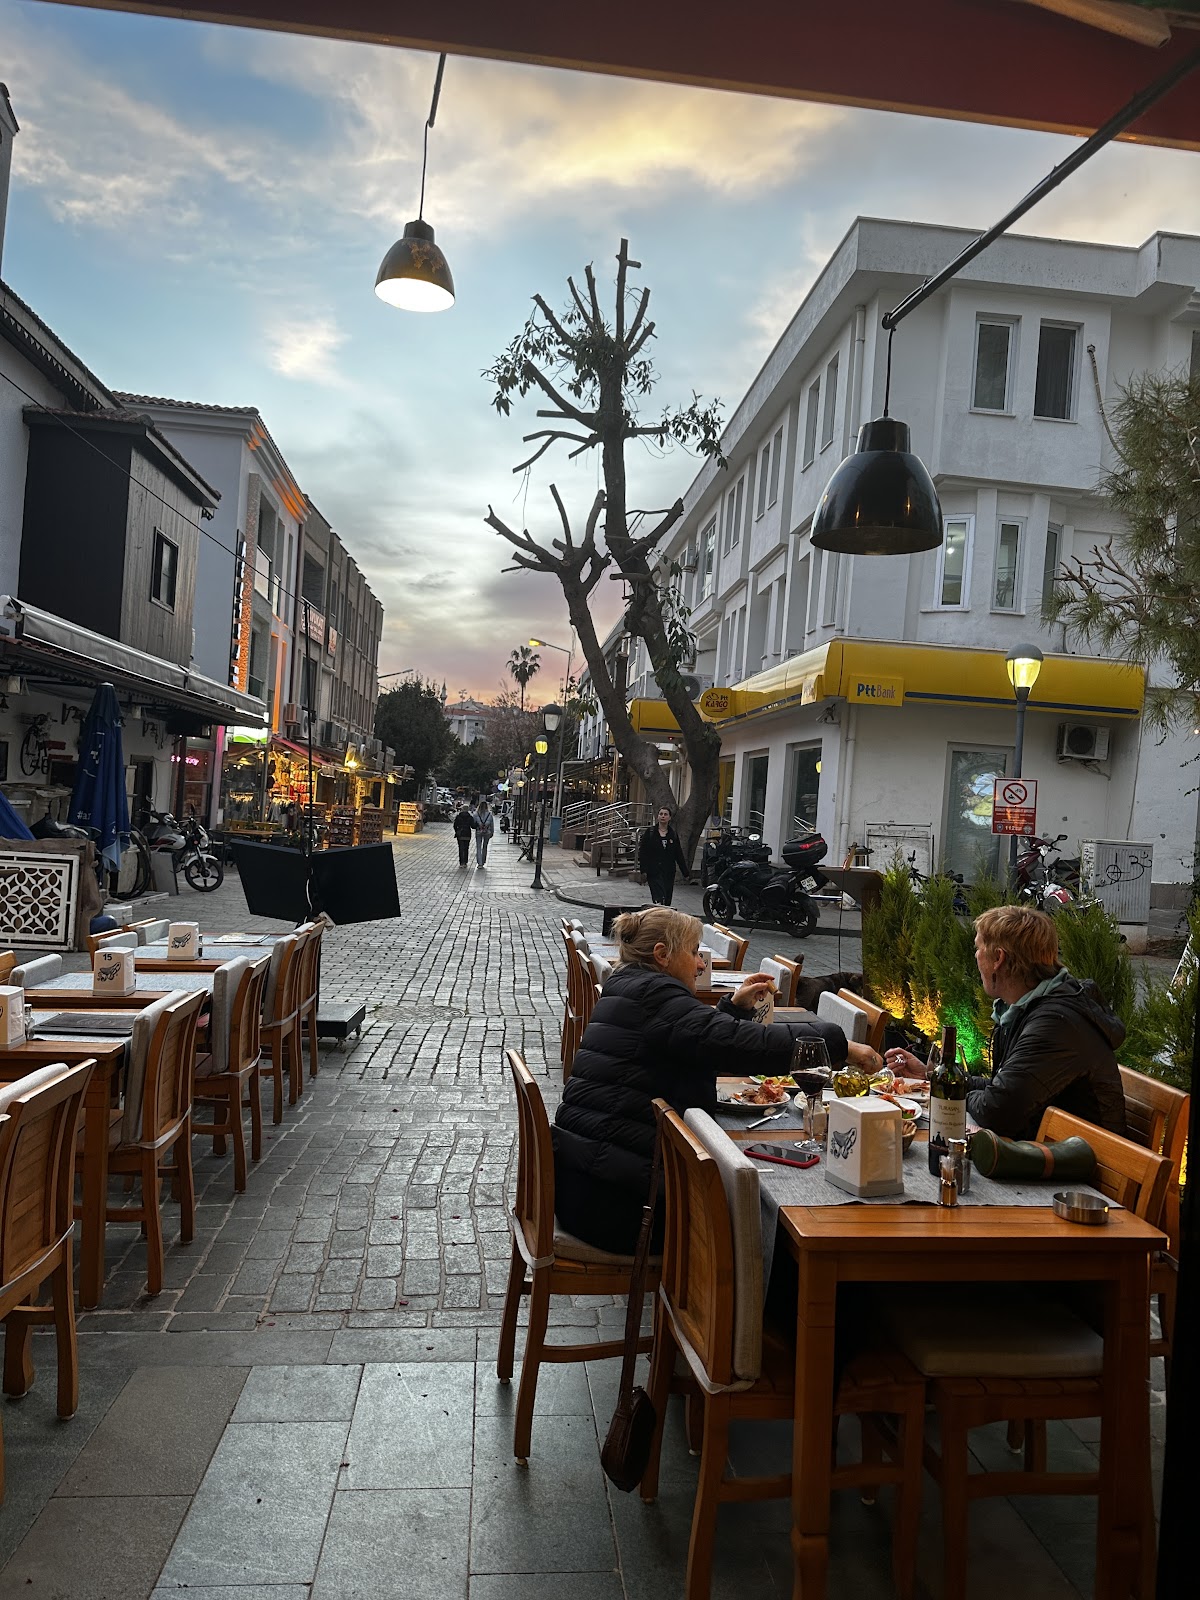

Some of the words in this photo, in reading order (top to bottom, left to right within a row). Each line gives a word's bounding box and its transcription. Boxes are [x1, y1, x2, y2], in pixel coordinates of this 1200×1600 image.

[857, 683, 896, 699] PttBank
[706, 700, 728, 708] KARGO
[103, 953, 112, 961] 15
